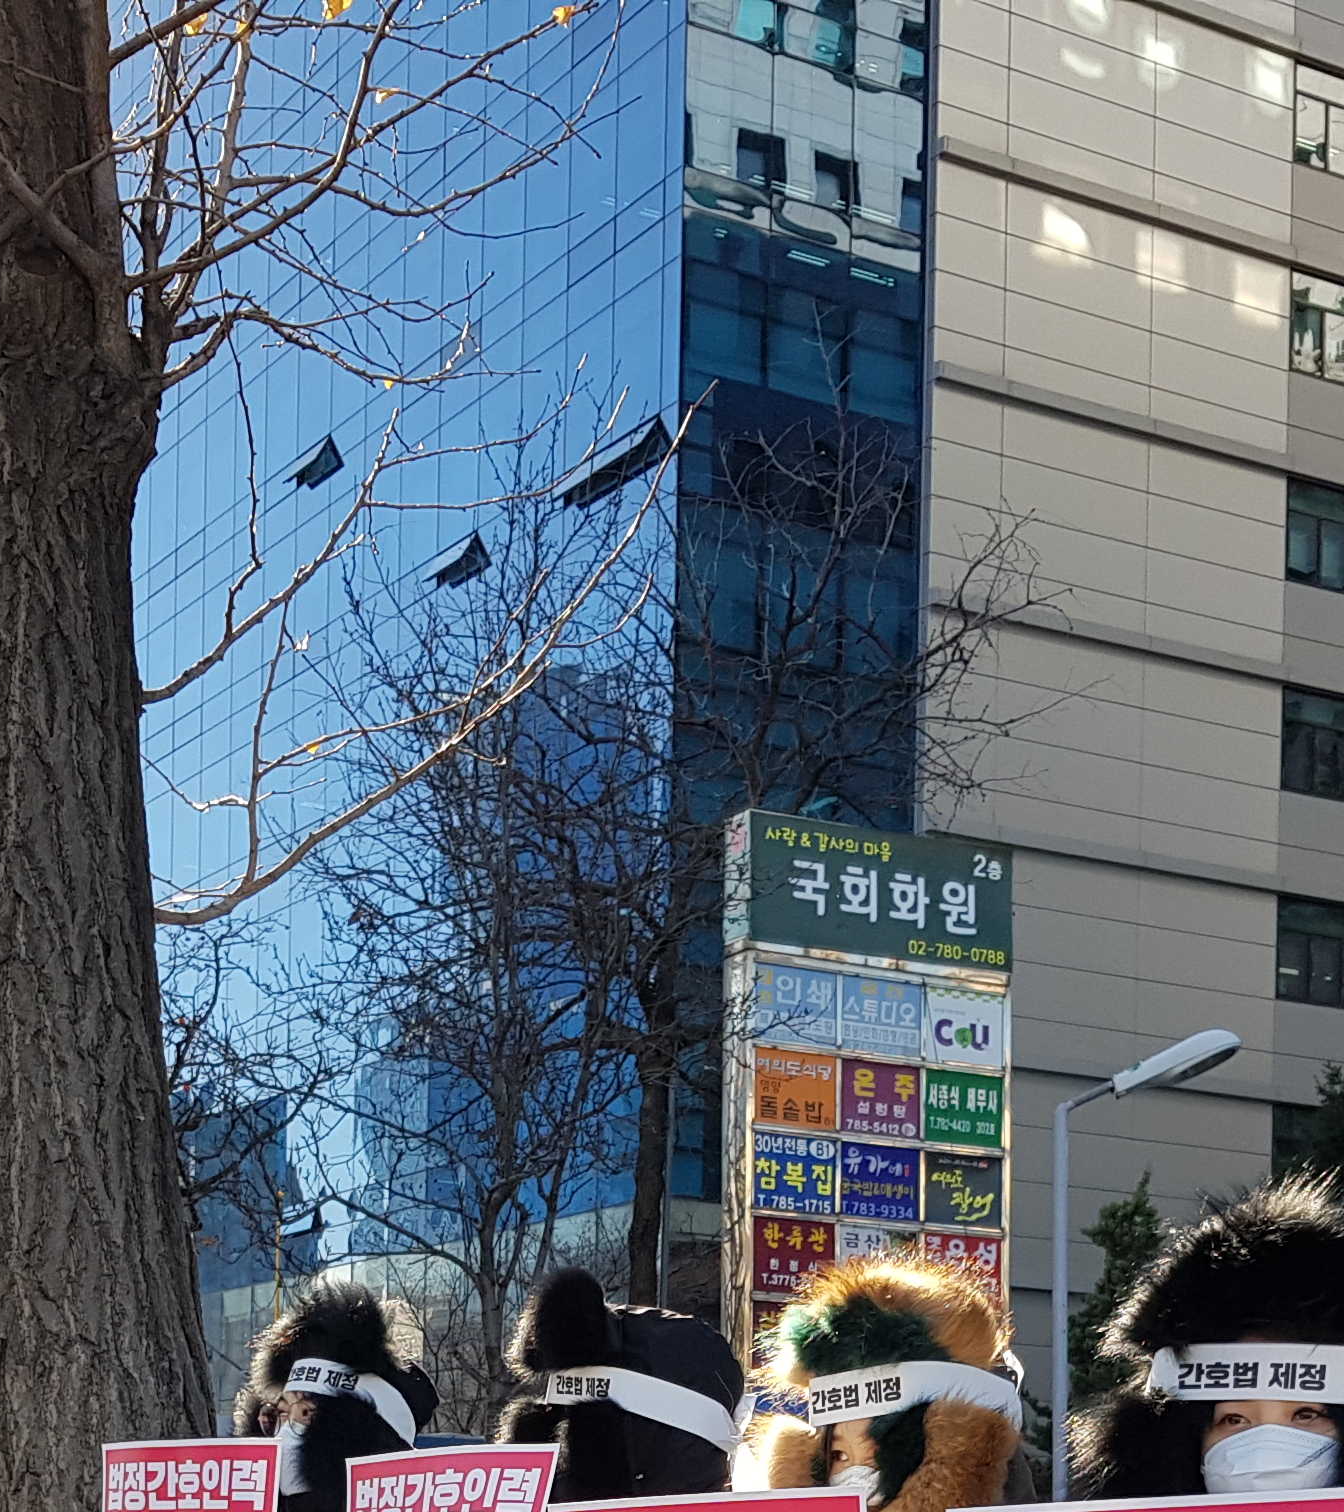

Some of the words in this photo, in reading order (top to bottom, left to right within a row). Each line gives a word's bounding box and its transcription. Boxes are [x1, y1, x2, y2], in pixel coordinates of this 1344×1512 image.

[765, 826, 797, 847] 사랑
[800, 833, 812, 848] &
[816, 831, 859, 854] 감사의
[863, 840, 893, 863] 마음
[973, 854, 1003, 881] 2층
[788, 858, 978, 936] 국회화원
[909, 940, 1006, 965] 02-780-0788
[776, 974, 833, 1012] 인쇄
[843, 995, 916, 1028] 스튜디오
[934, 1018, 991, 1052] CU
[757, 1058, 833, 1081] 여의도식당
[761, 1096, 824, 1124] 돌솥밥
[966, 1087, 997, 1114] 세무사
[846, 1118, 900, 1135] 785-5412
[755, 1133, 808, 1157] 30년전통
[816, 1142, 831, 1158] B1
[843, 1146, 903, 1177] 유가네
[755, 1157, 833, 1196] 참복집
[757, 1193, 832, 1214] T.785-1715
[842, 1200, 914, 1219] T.783-9334
[762, 1221, 828, 1252] 한류관
[323, 1370, 359, 1391] 제정
[556, 1374, 584, 1396] 간호법
[586, 1377, 611, 1398] 제정
[1177, 1361, 1260, 1391] 간호법
[1267, 1360, 1328, 1393] 제정
[811, 1386, 860, 1414] 간호법
[863, 1374, 903, 1403] 제정
[107, 1458, 268, 1512] 법정간호인력
